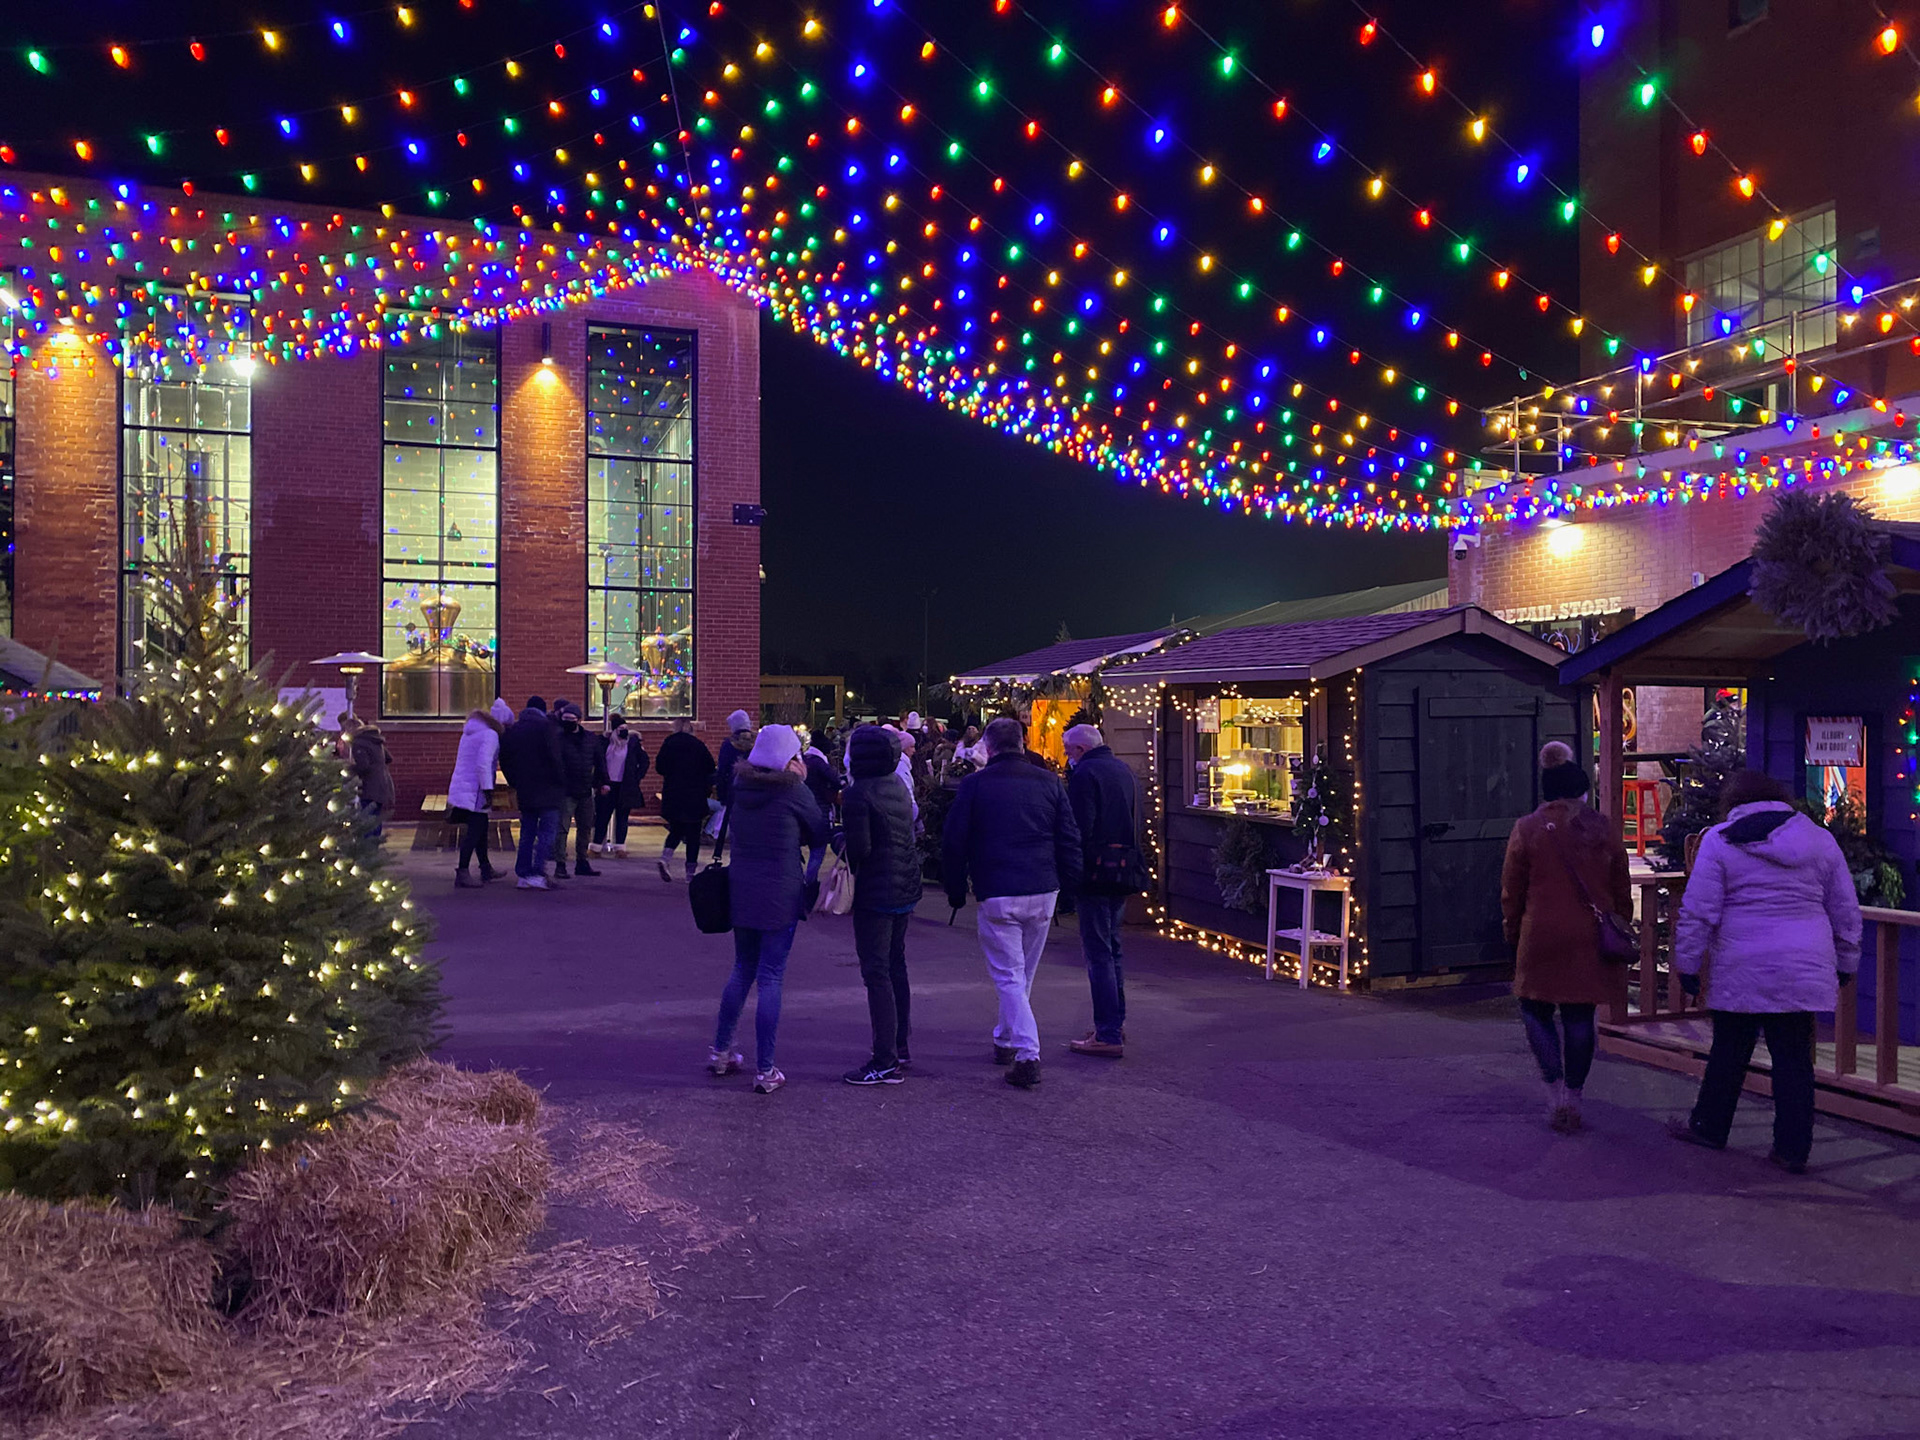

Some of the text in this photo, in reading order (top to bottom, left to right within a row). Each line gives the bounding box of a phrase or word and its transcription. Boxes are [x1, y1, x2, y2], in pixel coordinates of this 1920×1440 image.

[1493, 597, 1622, 624] RETAIL STORE
[1816, 742, 1847, 751] AND GOOSE
